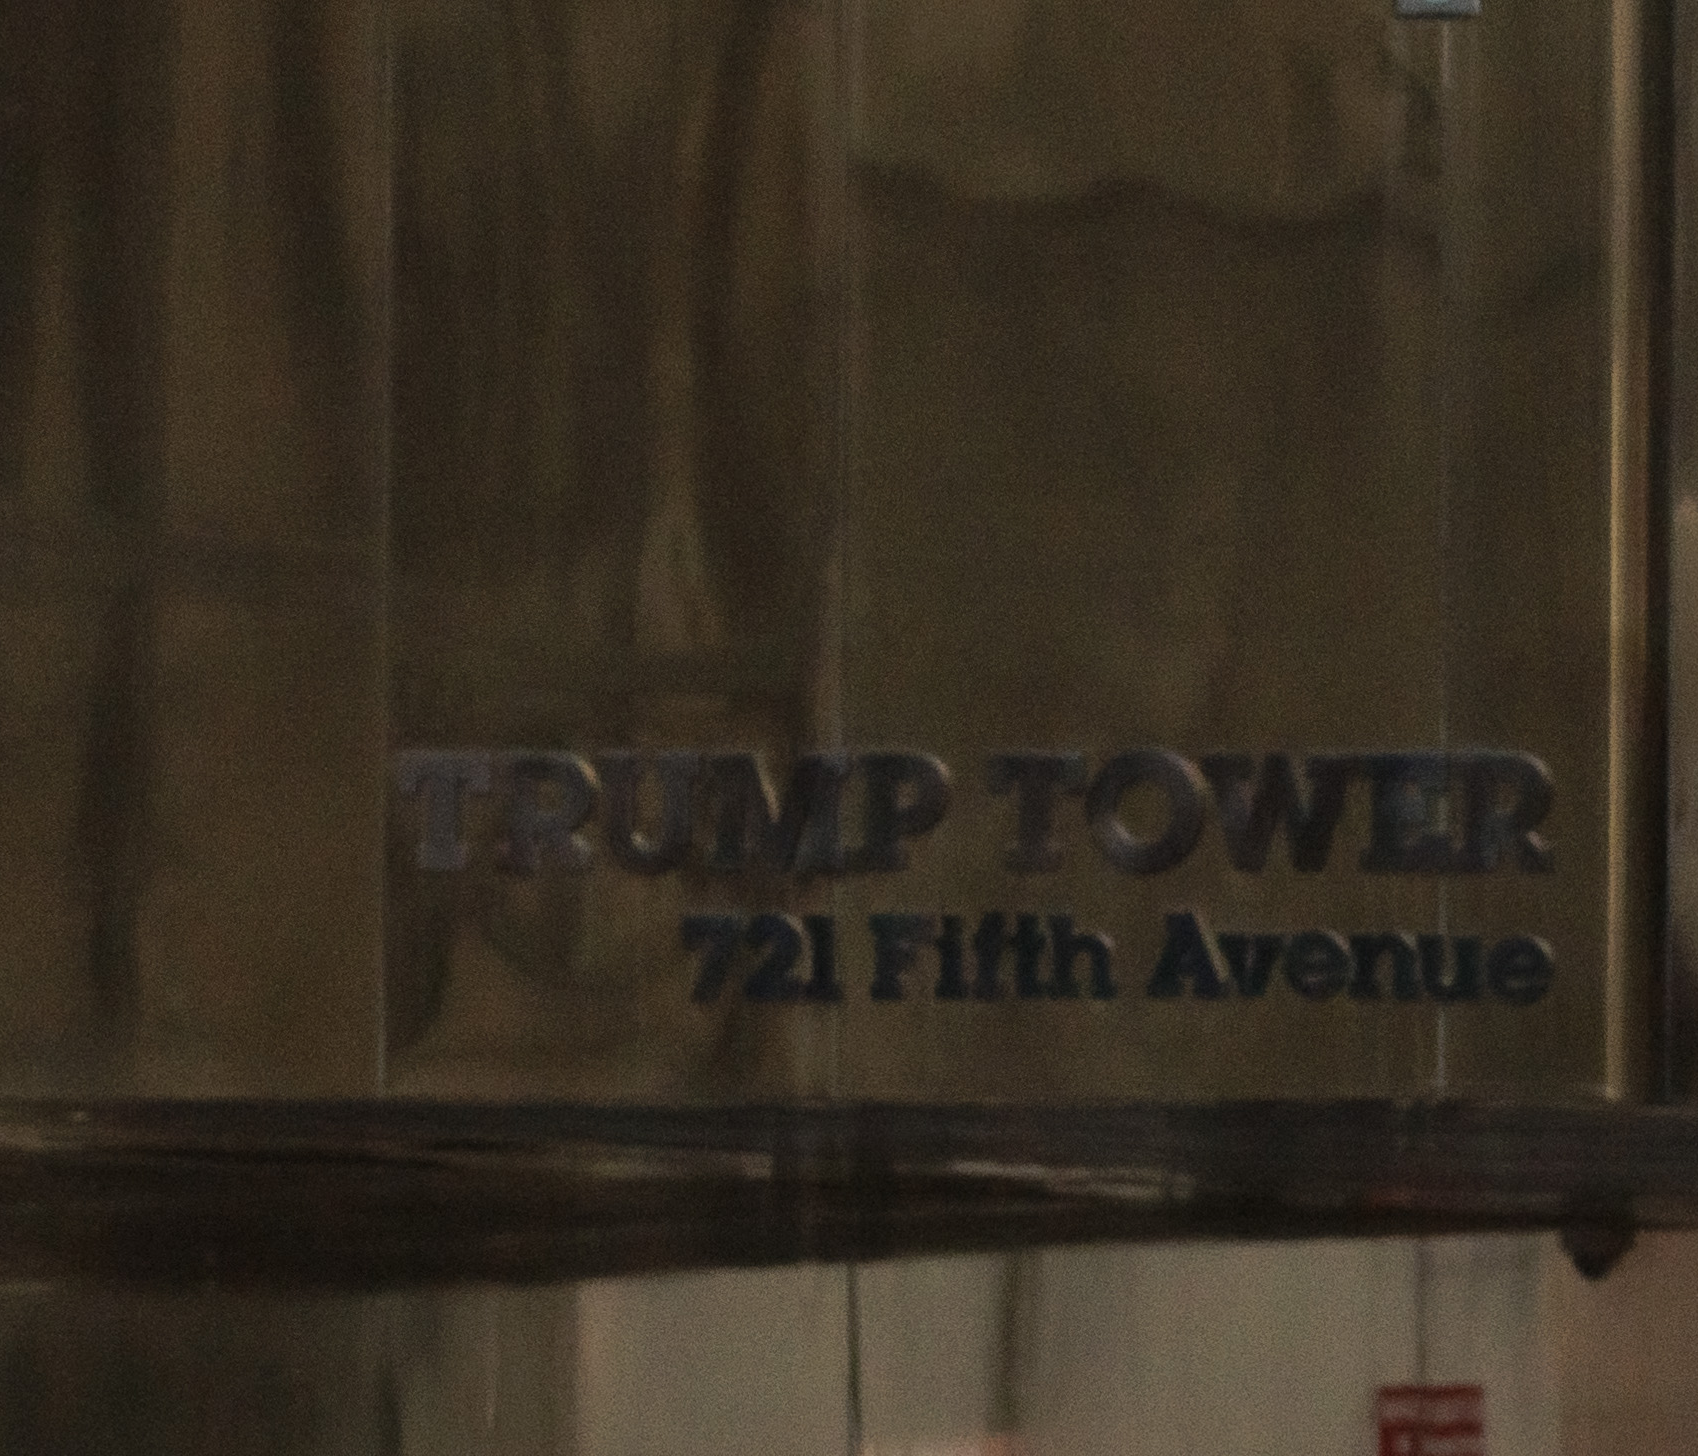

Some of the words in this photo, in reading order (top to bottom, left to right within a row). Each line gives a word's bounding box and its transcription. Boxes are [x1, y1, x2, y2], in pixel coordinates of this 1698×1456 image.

[393, 747, 955, 876] TRUMP
[988, 744, 1559, 877] TOWER
[682, 911, 847, 1003] 721
[870, 909, 1118, 1003] Fifth
[1146, 909, 1556, 1003] Avenue
